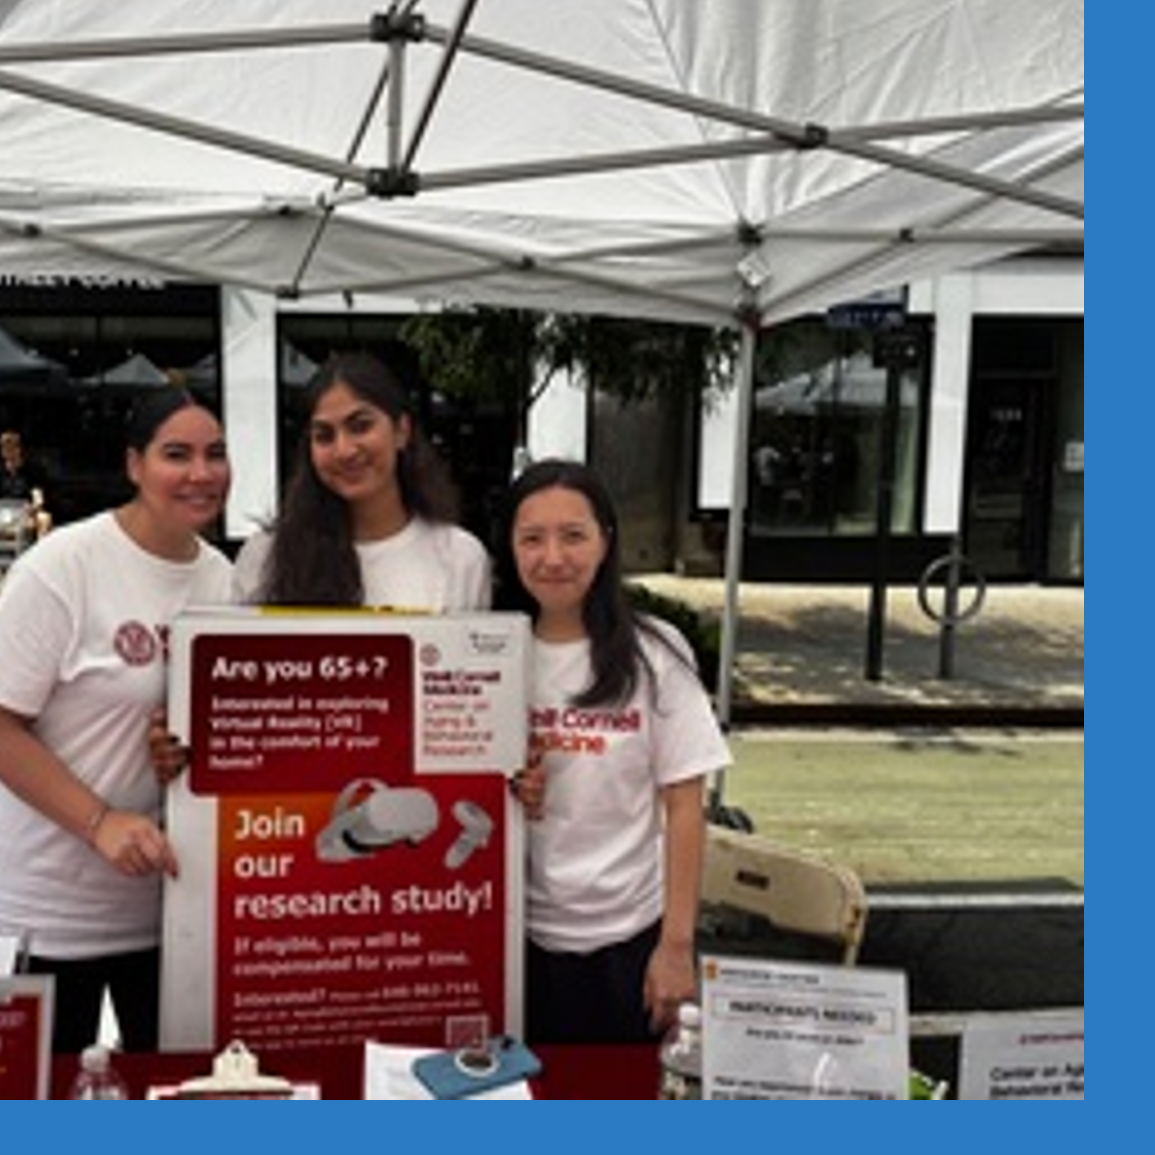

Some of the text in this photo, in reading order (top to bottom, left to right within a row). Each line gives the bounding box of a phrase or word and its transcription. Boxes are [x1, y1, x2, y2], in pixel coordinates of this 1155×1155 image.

[211, 656, 389, 685] Are you 65+?
[211, 696, 390, 714] Interested in exploring
[267, 714, 322, 734] Reality
[562, 708, 641, 733] Cornell
[230, 735, 256, 750] the
[258, 733, 322, 750] comfort
[325, 732, 342, 749] of
[344, 735, 381, 753] your
[234, 807, 306, 841] Join
[233, 853, 295, 879] our
[233, 880, 494, 921] research study!
[329, 935, 362, 954] you
[365, 931, 397, 949] will
[400, 931, 422, 948] be
[233, 957, 351, 980] compensated
[355, 955, 380, 972] for
[385, 953, 424, 973] your
[233, 988, 326, 1008] Interested?
[989, 1066, 1036, 1082] Center
